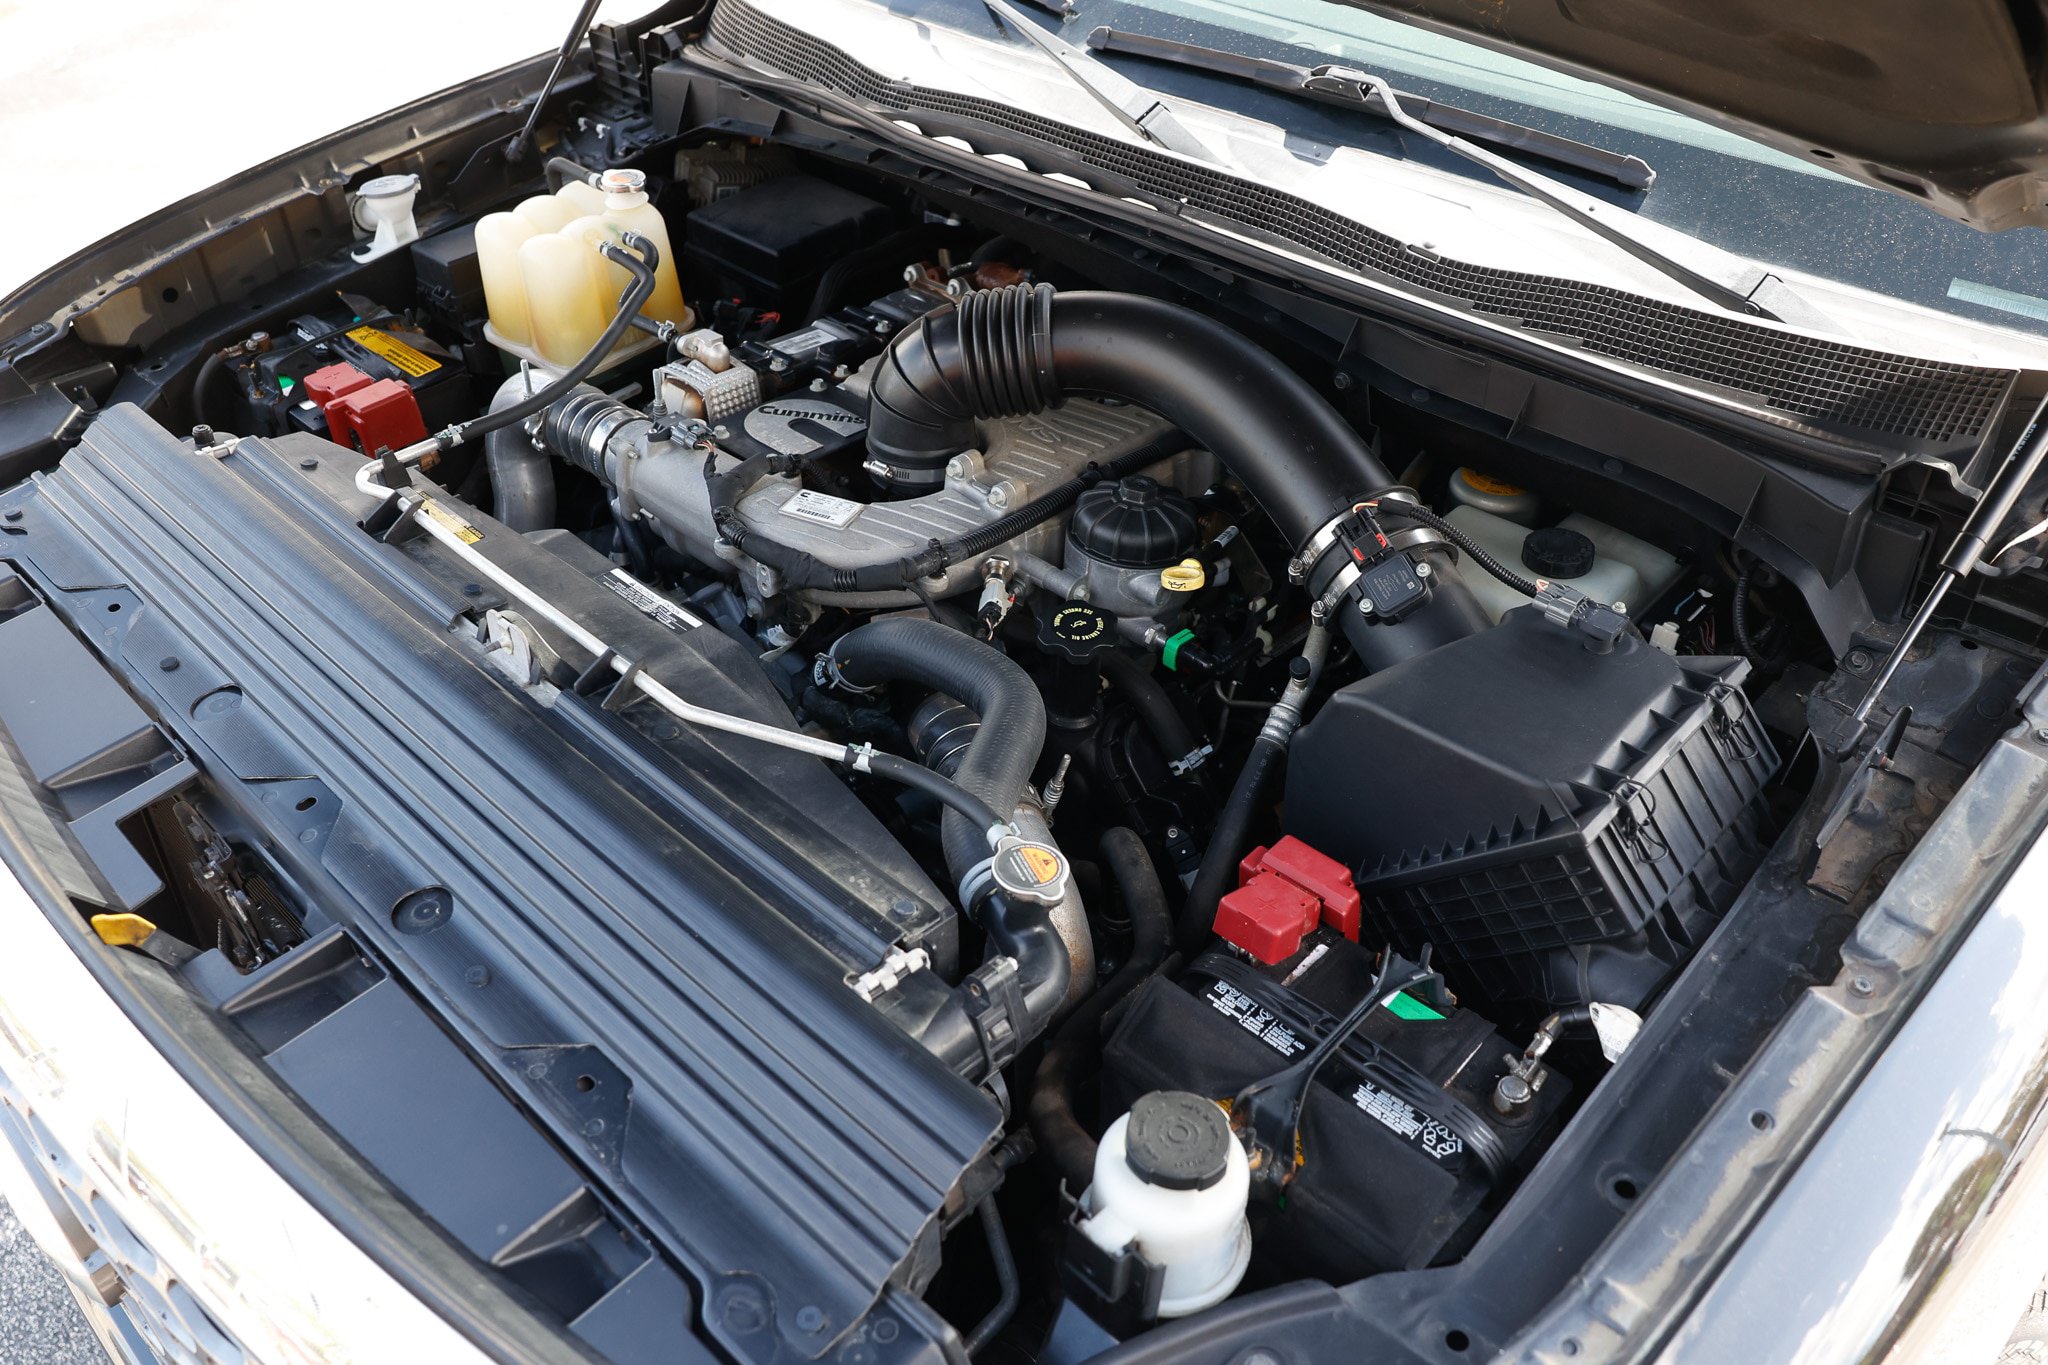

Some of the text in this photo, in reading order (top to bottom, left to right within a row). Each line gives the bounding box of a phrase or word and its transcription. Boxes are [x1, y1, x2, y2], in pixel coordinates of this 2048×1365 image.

[758, 405, 866, 424] Cummins
[1255, 1014, 1266, 1024] NO
[1292, 1039, 1306, 1051] ACID
